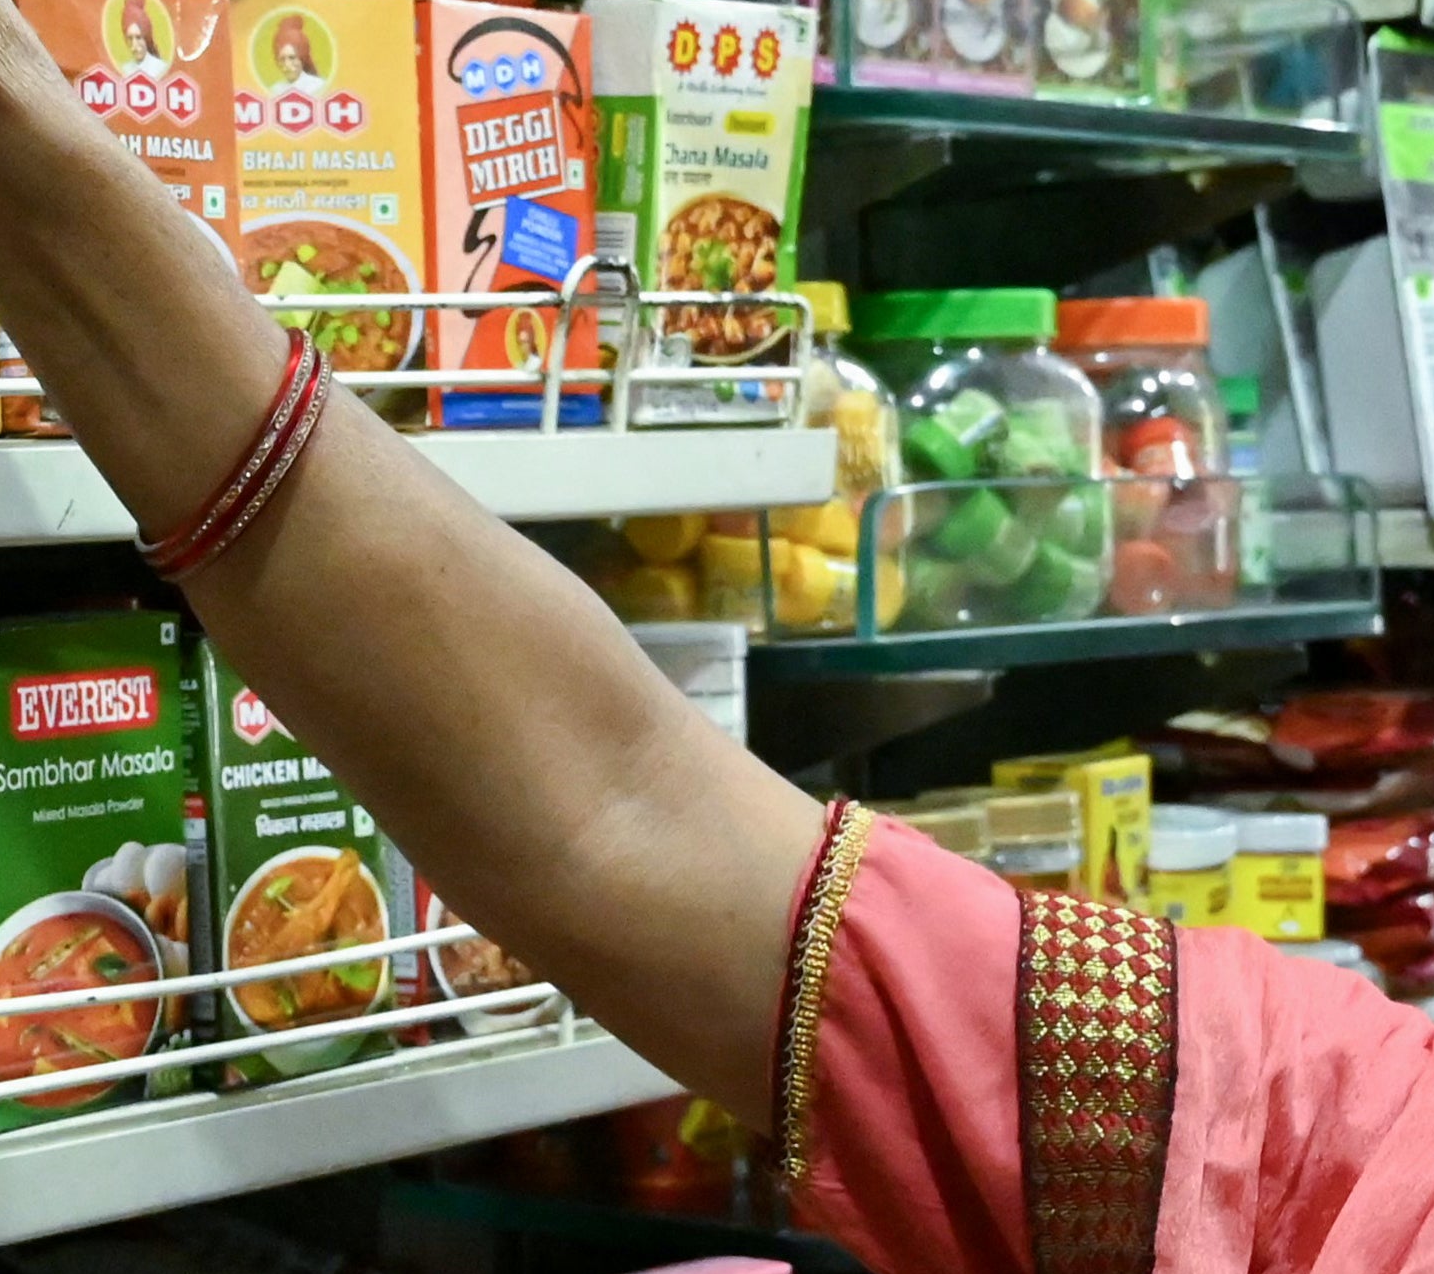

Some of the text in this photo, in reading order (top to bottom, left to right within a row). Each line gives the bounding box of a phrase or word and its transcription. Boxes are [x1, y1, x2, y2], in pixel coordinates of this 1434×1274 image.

[463, 107, 553, 157] DEGGI
[242, 150, 395, 173] BHAJI MASALA
[469, 143, 560, 196] MIRCH
[16, 675, 154, 733] EVEREST
[100, 745, 175, 780] Masala
[221, 757, 299, 791] CHICKEN
[32, 797, 145, 823] Mixed Masala Powder
